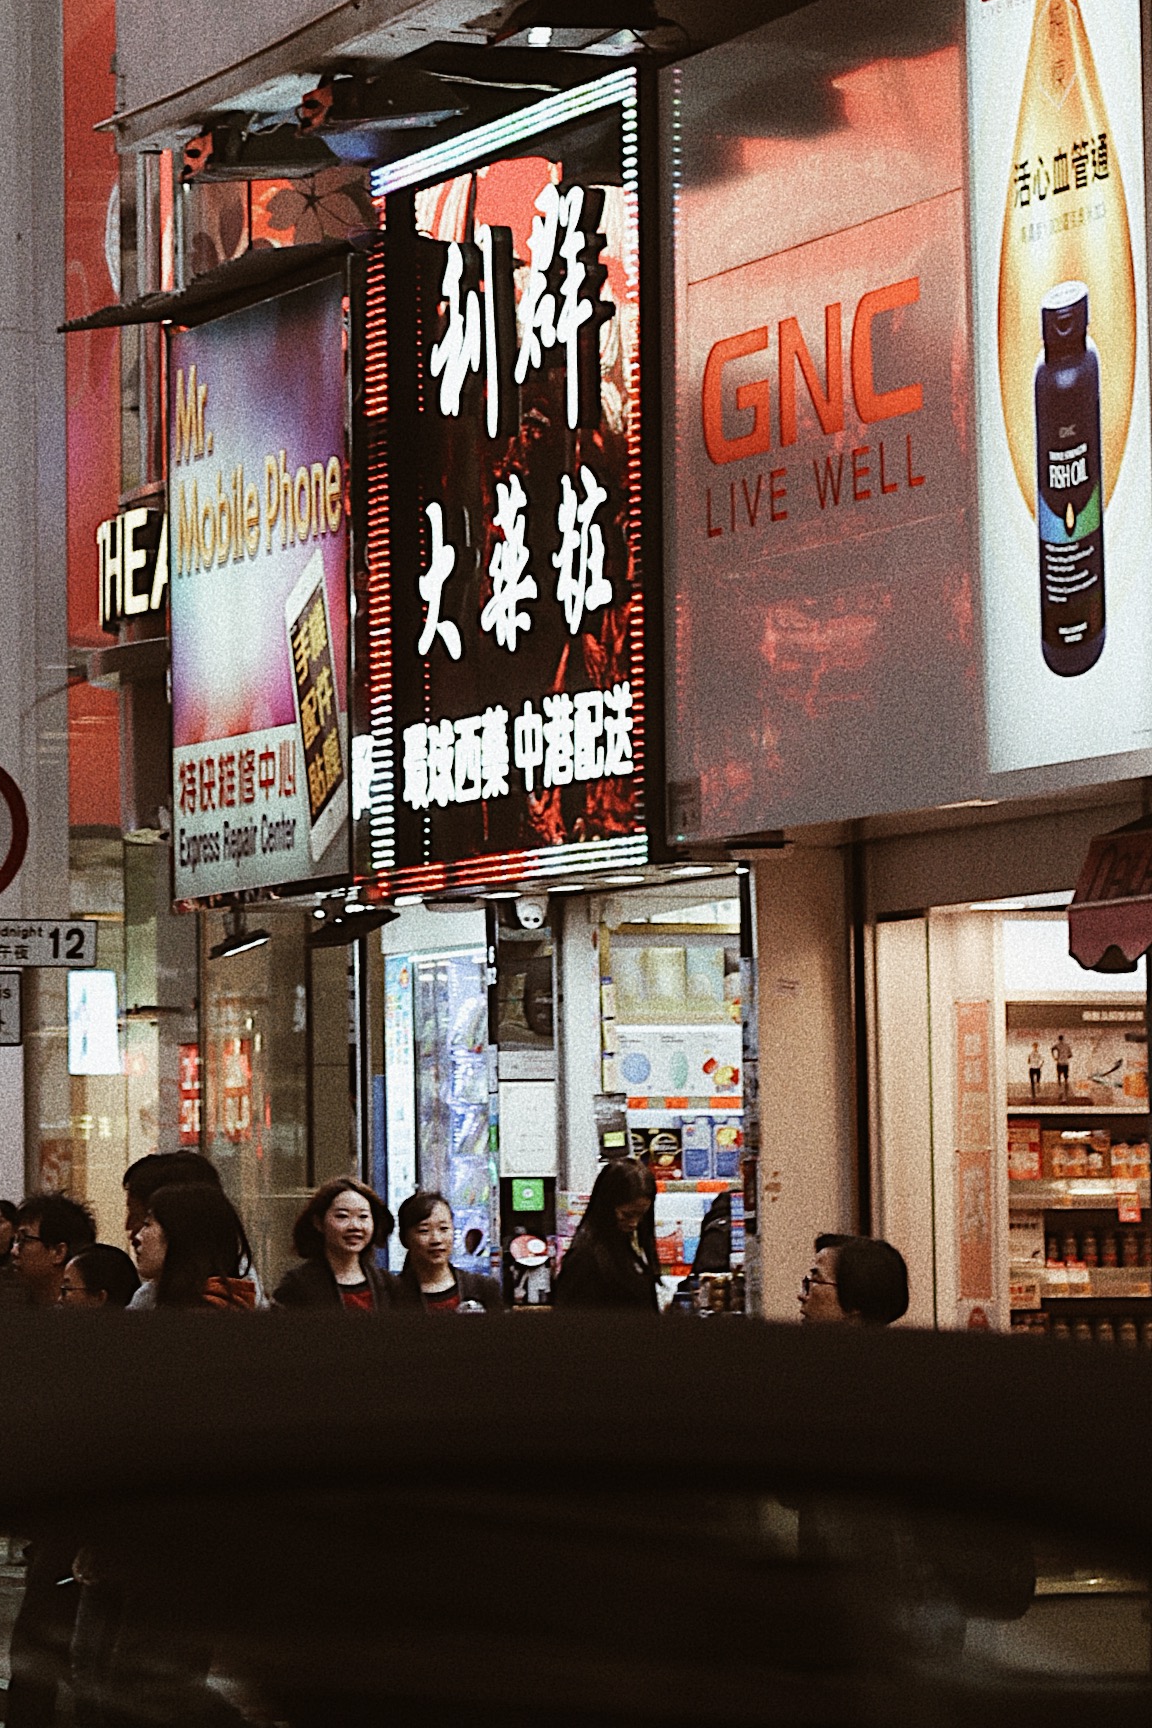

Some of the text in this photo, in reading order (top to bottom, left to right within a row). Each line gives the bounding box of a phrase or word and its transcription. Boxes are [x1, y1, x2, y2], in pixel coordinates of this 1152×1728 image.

[1013, 132, 1111, 209] 活心血管通
[702, 275, 924, 467] GNC
[175, 364, 215, 465] Mr.
[705, 432, 927, 540] LIVE WELL
[1048, 457, 1090, 489] FISH OIL
[176, 449, 343, 577] Mobile Phone
[178, 740, 297, 816] 特快維修中心
[179, 810, 297, 873] Express Repair Center
[48, 927, 85, 959] 12
